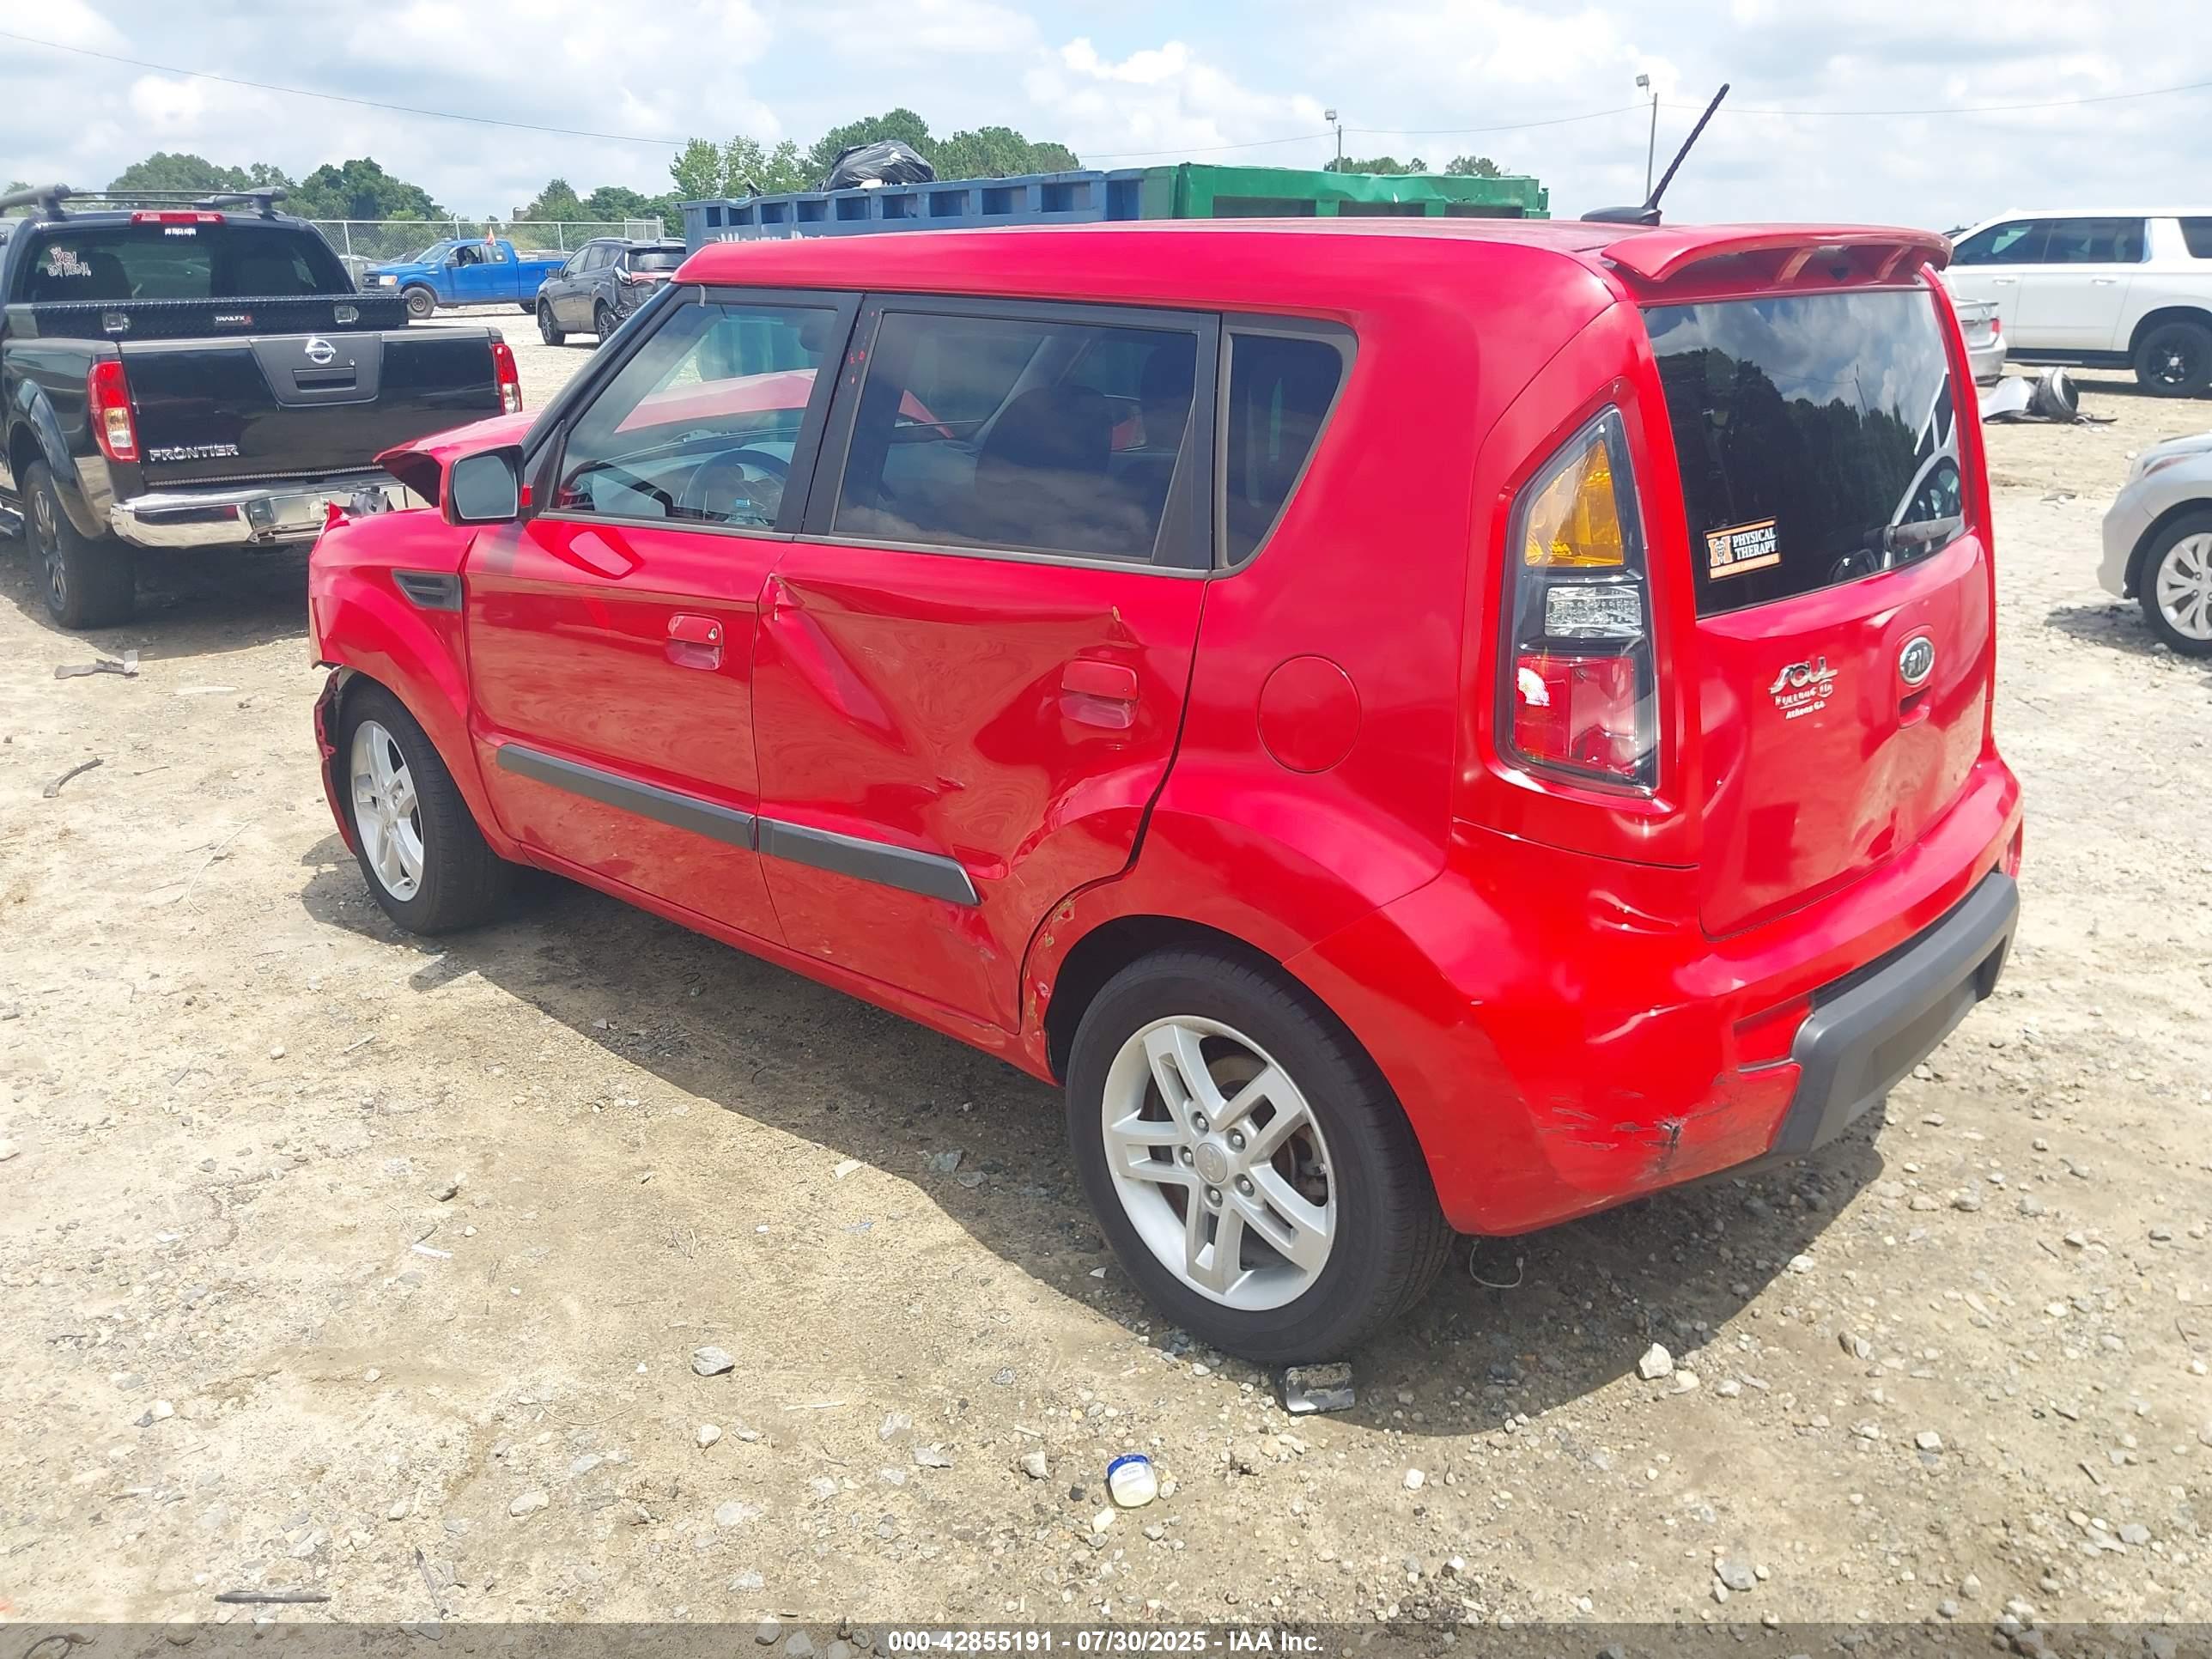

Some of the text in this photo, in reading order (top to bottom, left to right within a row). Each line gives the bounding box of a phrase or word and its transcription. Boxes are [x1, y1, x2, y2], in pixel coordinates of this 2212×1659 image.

[149, 442, 240, 462] FRONTIER
[1732, 526, 1777, 548] PHYSICAL
[1735, 539, 1778, 560] THERAPY
